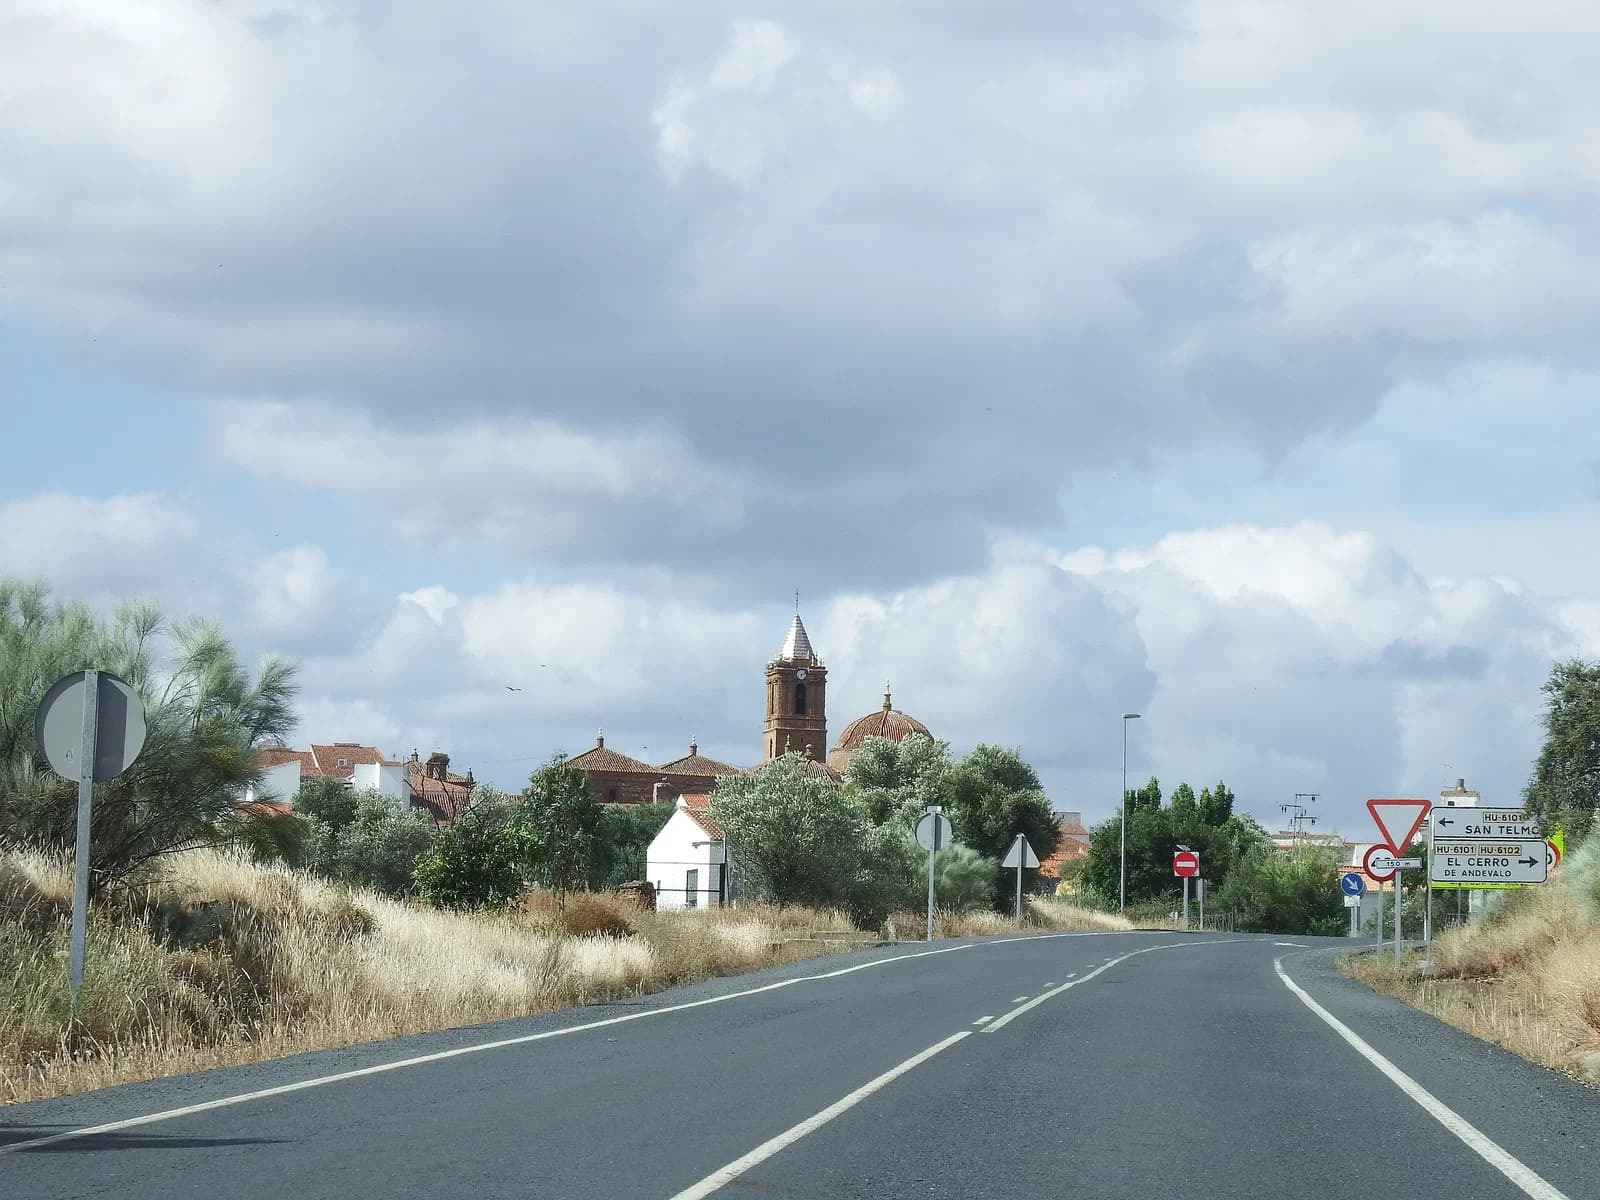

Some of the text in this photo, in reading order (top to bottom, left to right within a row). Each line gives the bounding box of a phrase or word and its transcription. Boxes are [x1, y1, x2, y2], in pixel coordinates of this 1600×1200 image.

[1465, 825, 1491, 835] SAN
[1436, 846, 1474, 854] HU-6101
[1480, 846, 1520, 854] HU-6102
[1447, 858, 1509, 867] EL CERRO
[1461, 869, 1511, 877] ANDEVALO
